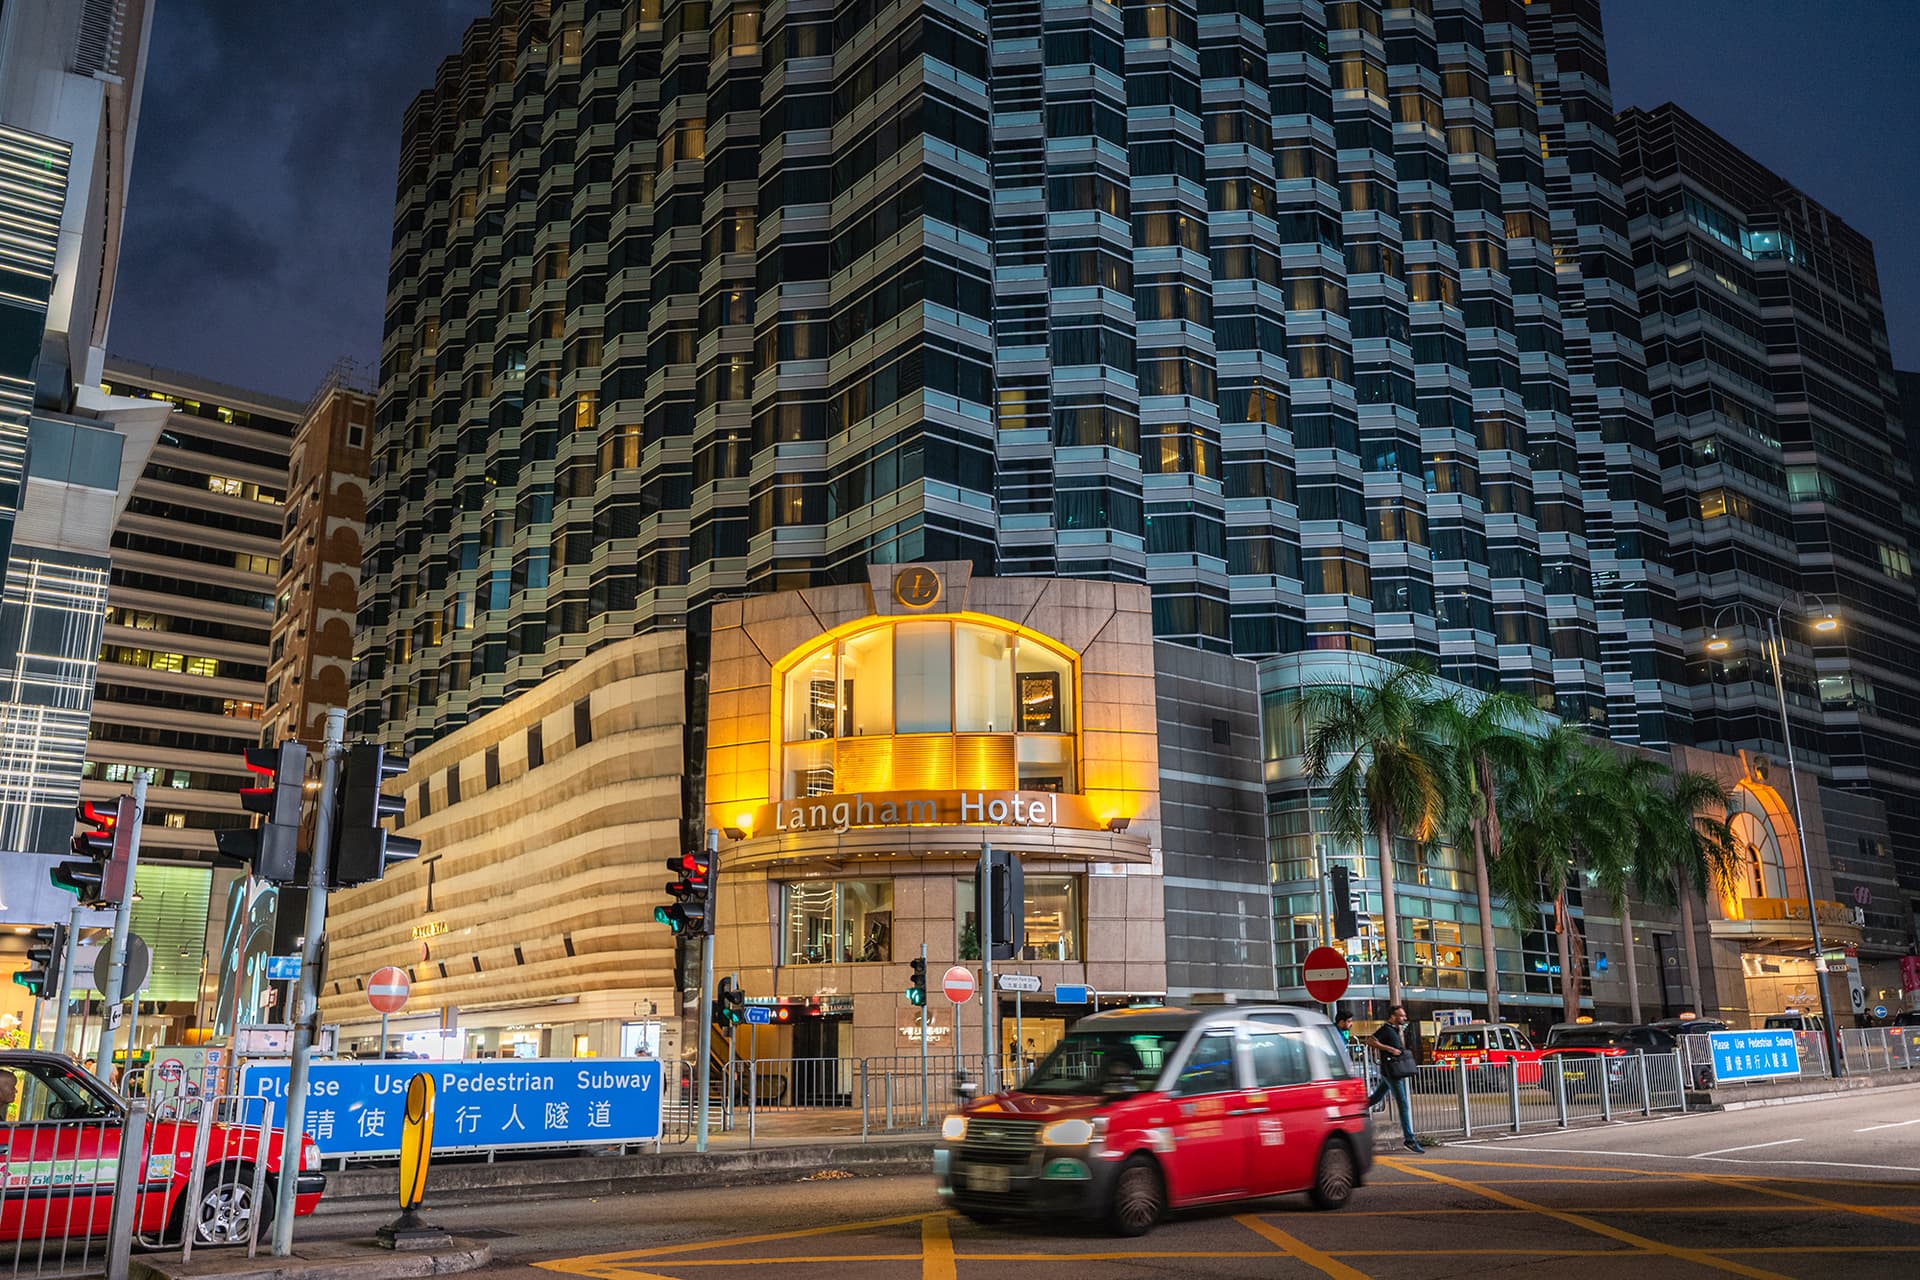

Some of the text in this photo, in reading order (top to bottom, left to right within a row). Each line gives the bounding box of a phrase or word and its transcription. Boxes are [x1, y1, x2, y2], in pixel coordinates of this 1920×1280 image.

[776, 792, 1057, 833] Langham Hotel
[1713, 1036, 1793, 1050] Please Use Pedestrian Subway
[442, 1073, 555, 1093] Pedestrian
[577, 1070, 652, 1091] Subway
[305, 1100, 612, 1141] 請使行人隧道
